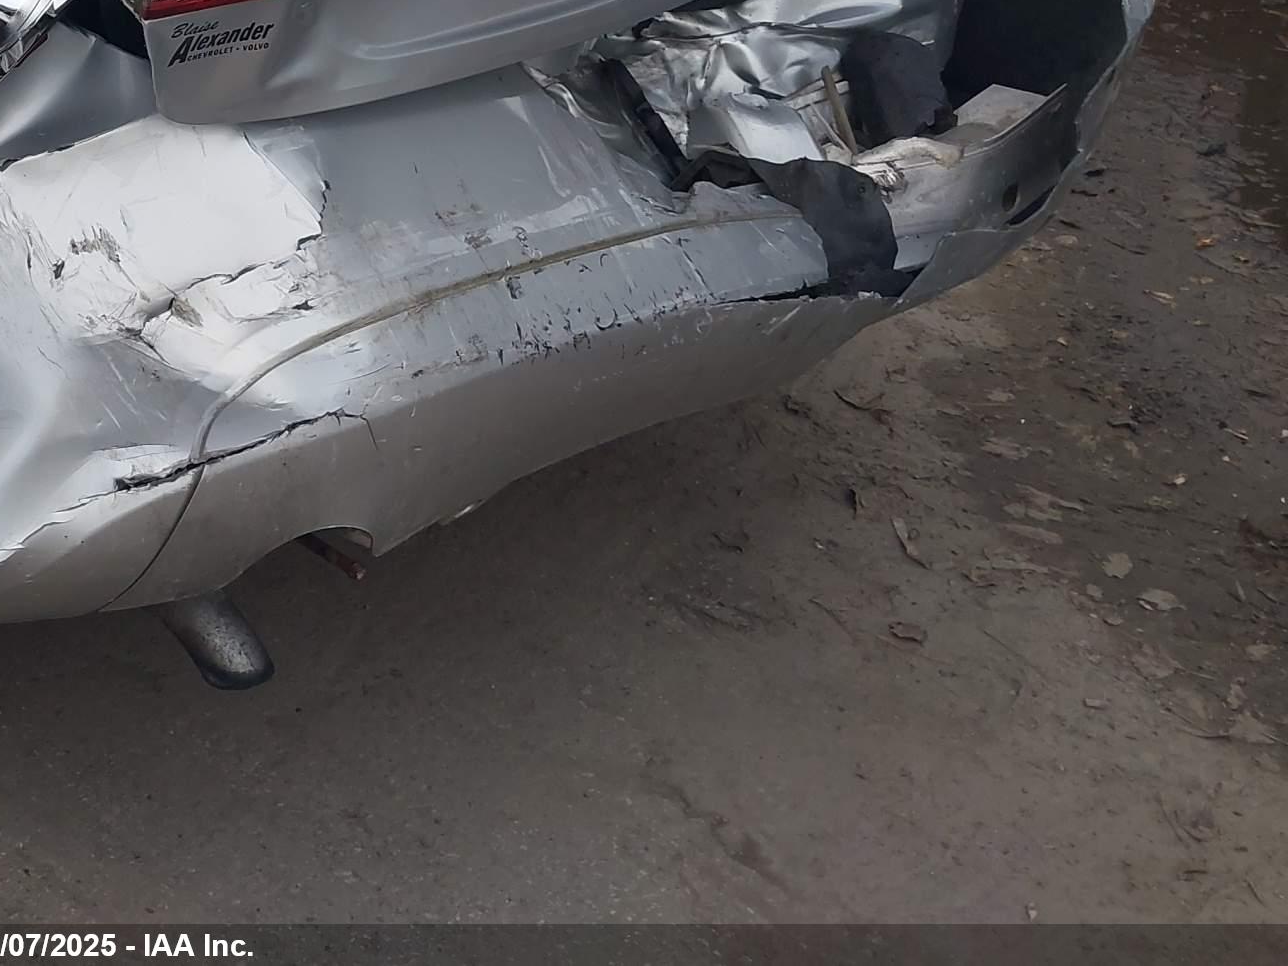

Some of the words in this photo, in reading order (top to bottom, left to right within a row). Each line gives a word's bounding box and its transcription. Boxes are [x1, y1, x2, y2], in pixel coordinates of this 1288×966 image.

[171, 20, 219, 38] Blaise
[167, 22, 275, 68] Alexander
[187, 46, 234, 61] CHEVROLET
[243, 42, 270, 52] VOLVO
